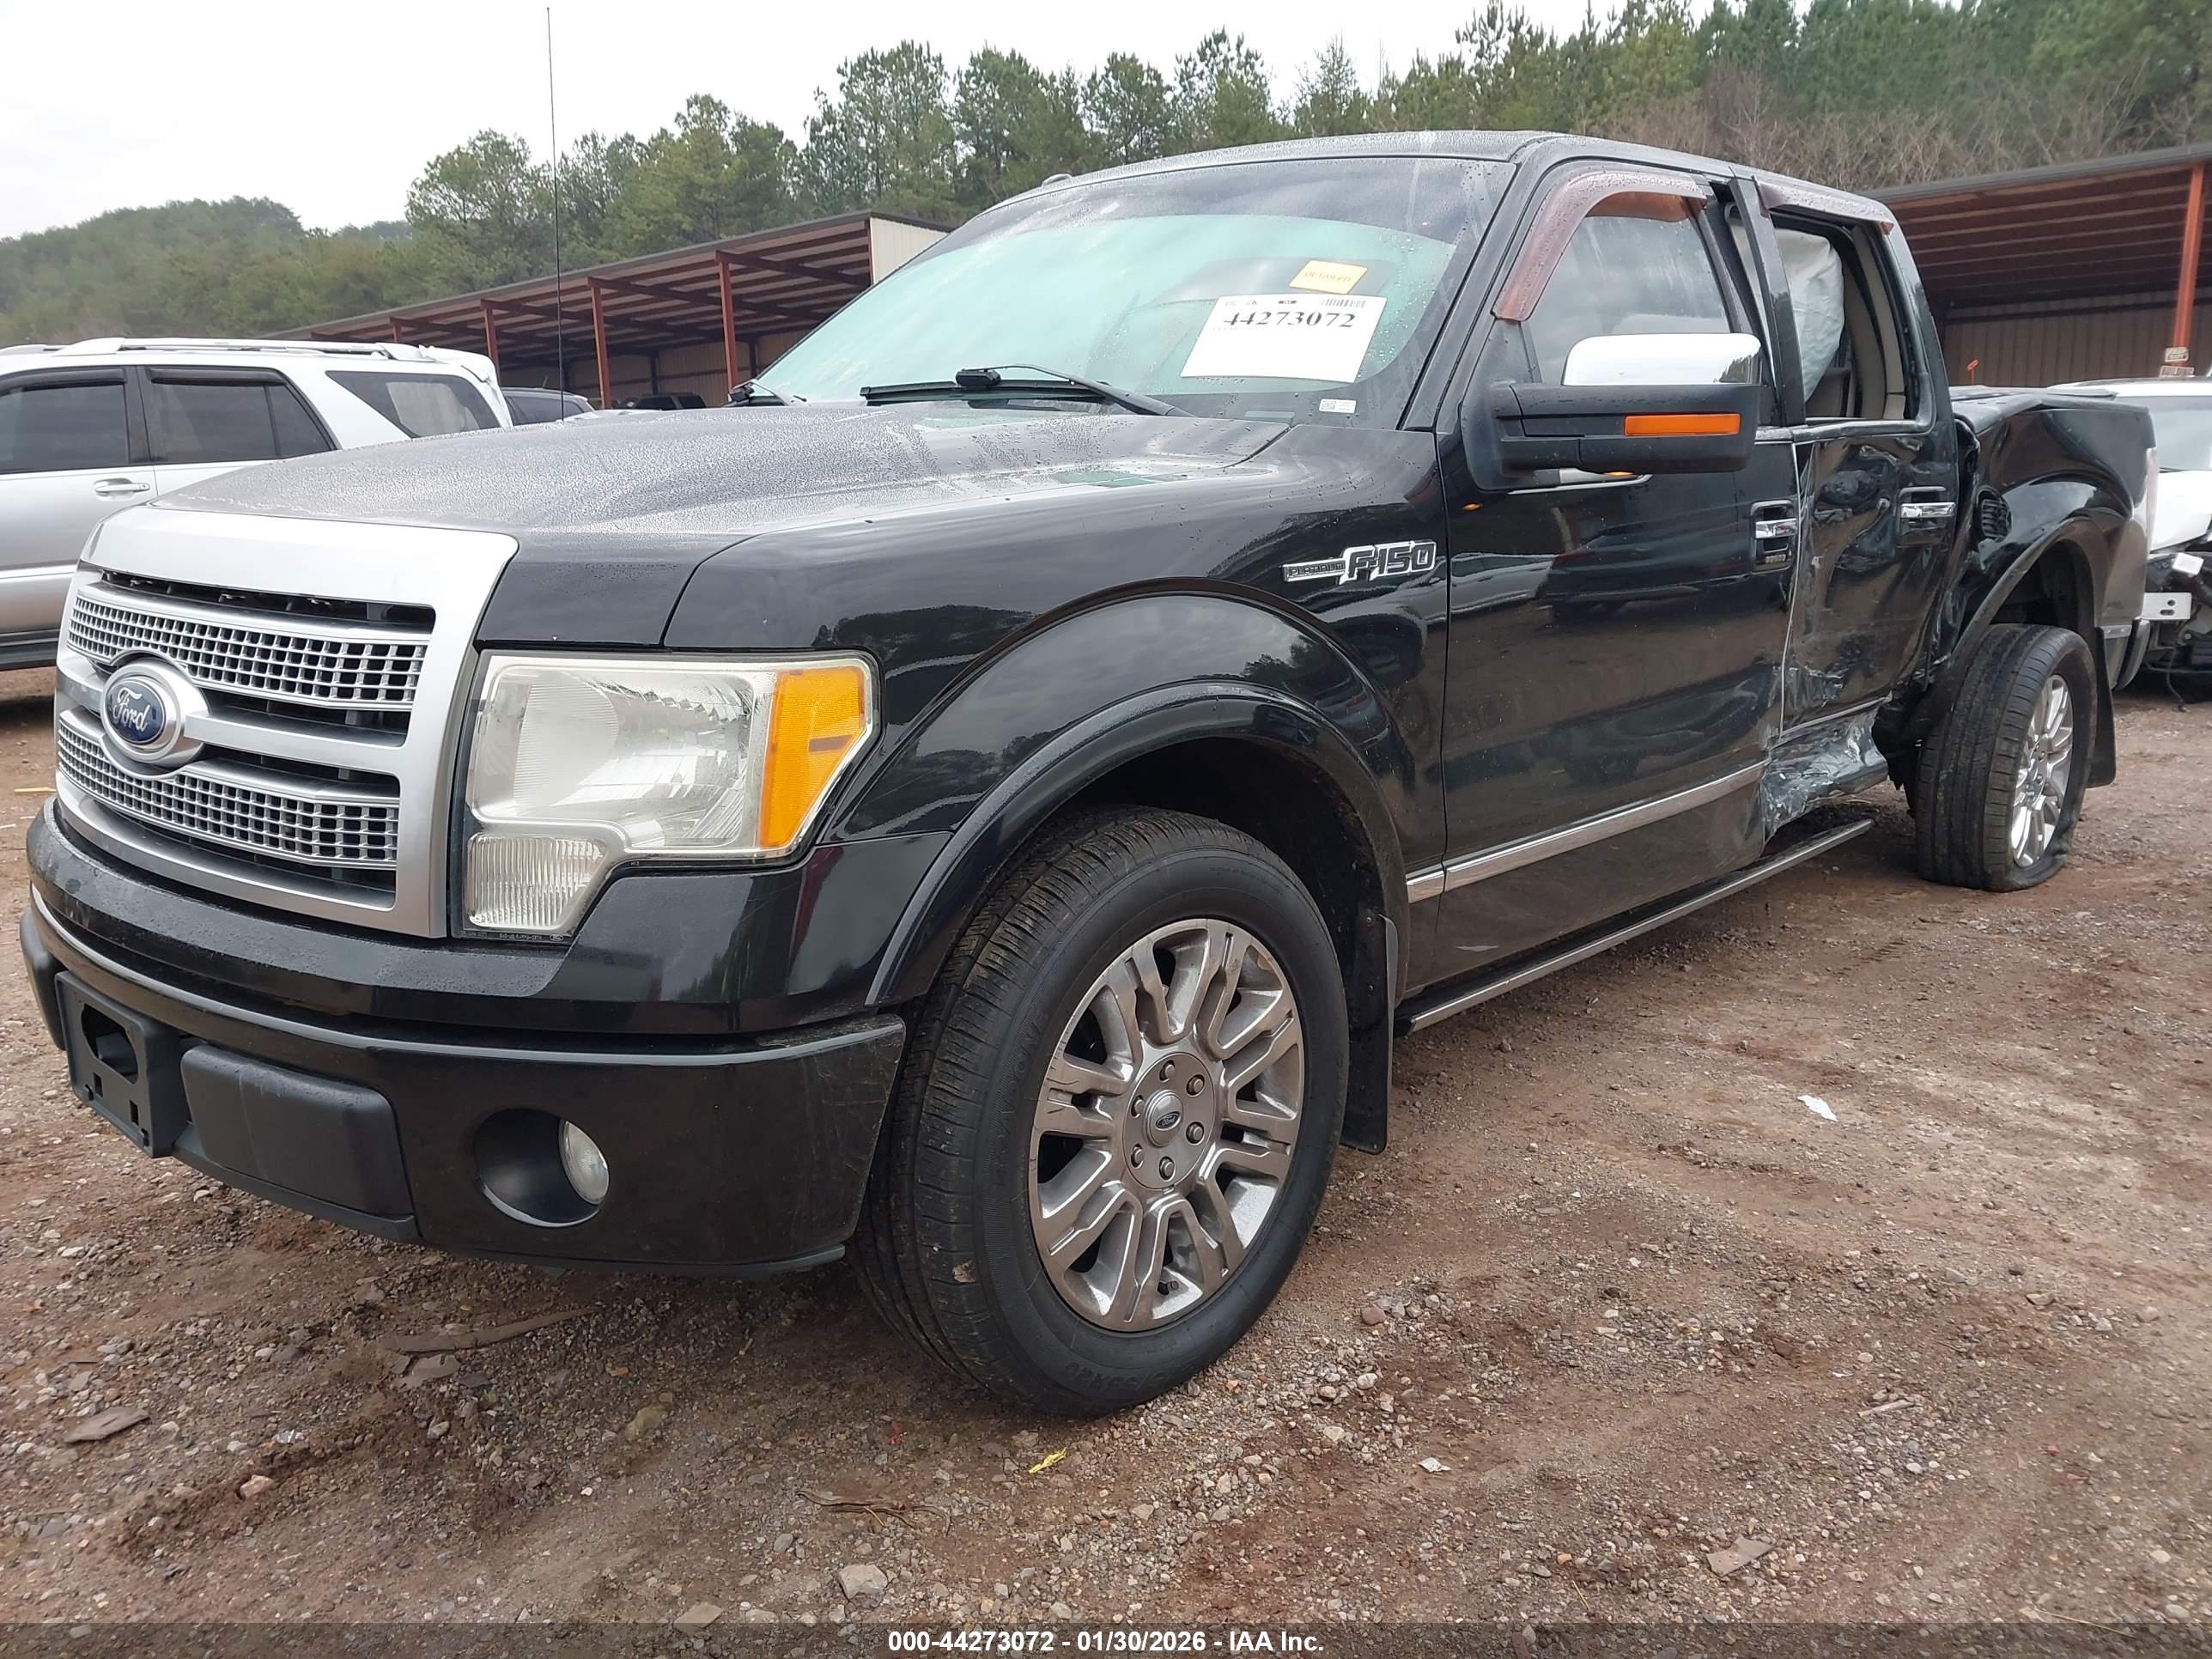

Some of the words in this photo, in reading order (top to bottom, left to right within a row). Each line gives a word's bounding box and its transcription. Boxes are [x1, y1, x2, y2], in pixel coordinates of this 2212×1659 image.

[1224, 311, 1356, 329] 44273072
[1289, 562, 1346, 577] PLATINUM
[1346, 542, 1437, 580] F-150
[112, 686, 150, 732] Ford
